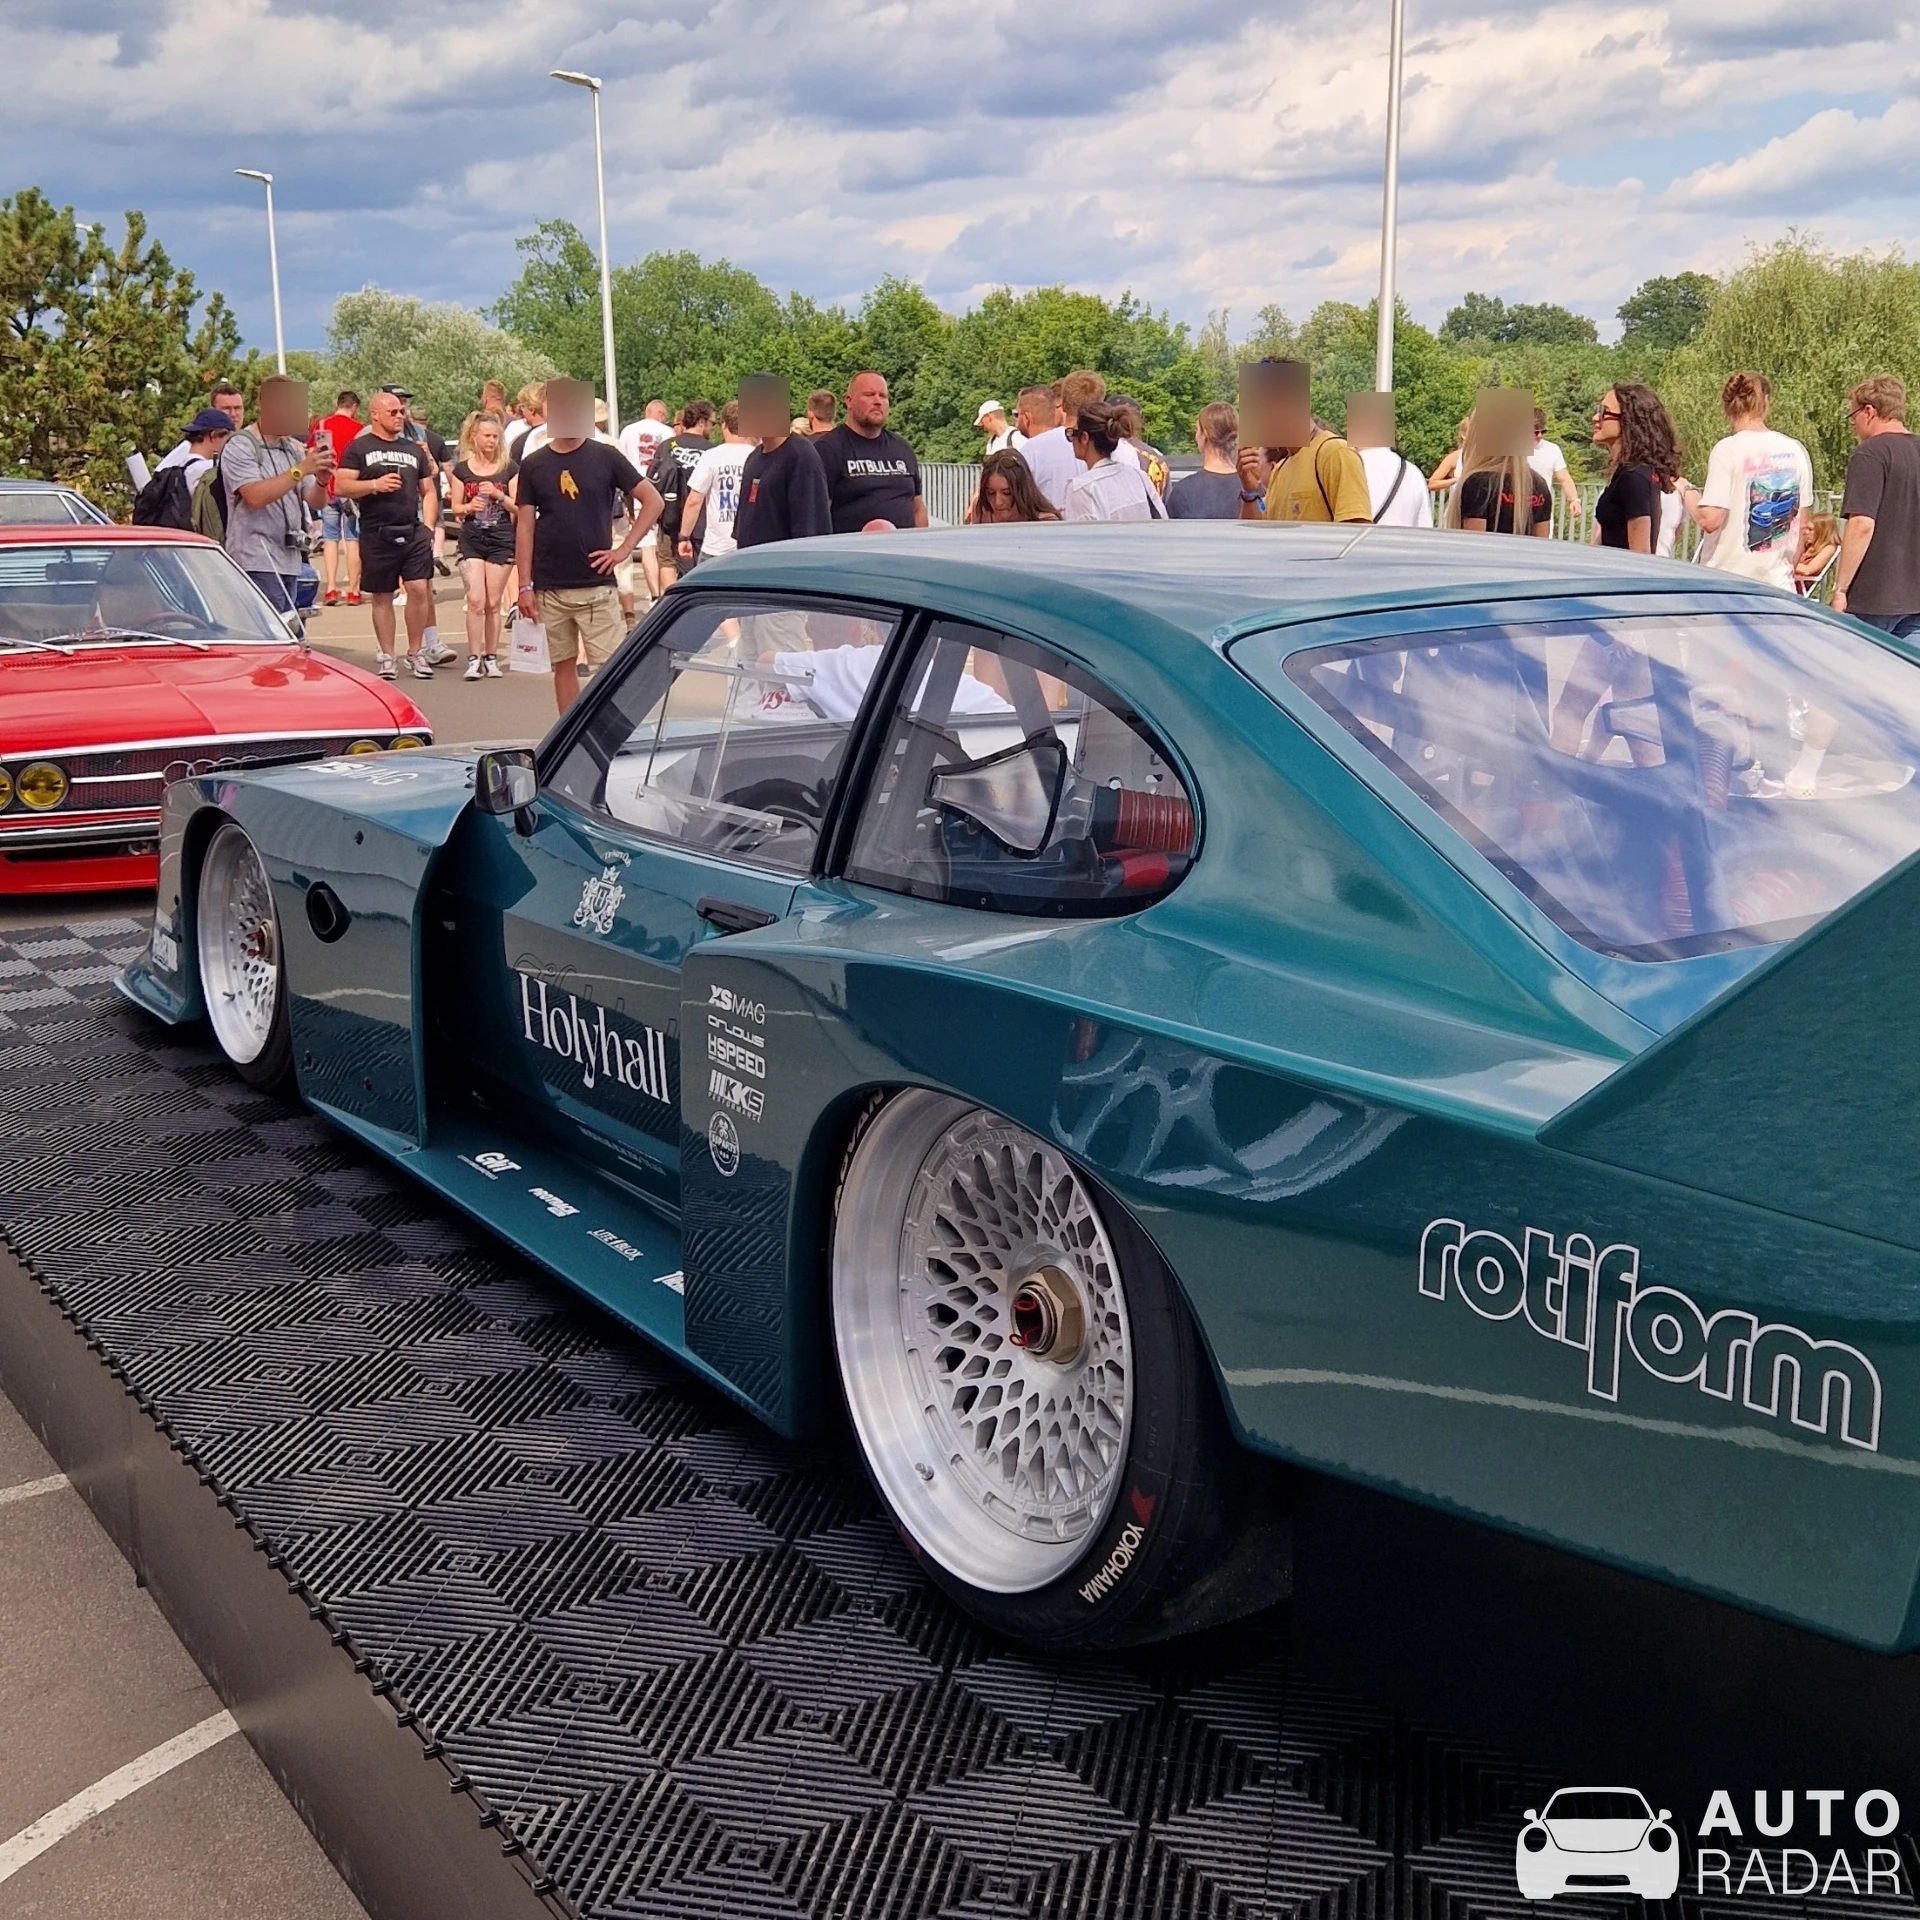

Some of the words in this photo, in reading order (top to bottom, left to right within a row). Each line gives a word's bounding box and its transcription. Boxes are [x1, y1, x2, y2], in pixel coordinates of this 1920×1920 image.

[718, 465, 742, 476] LOVE
[718, 477, 735, 490] TO
[847, 460, 897, 474] PITBULL
[708, 984, 766, 1026] XSMAG
[519, 973, 672, 1105] Holyhall
[708, 1033, 766, 1079] HSPEED
[1418, 1217, 1882, 1450] rotiform
[1079, 1522, 1144, 1603] YOKOHAMA
